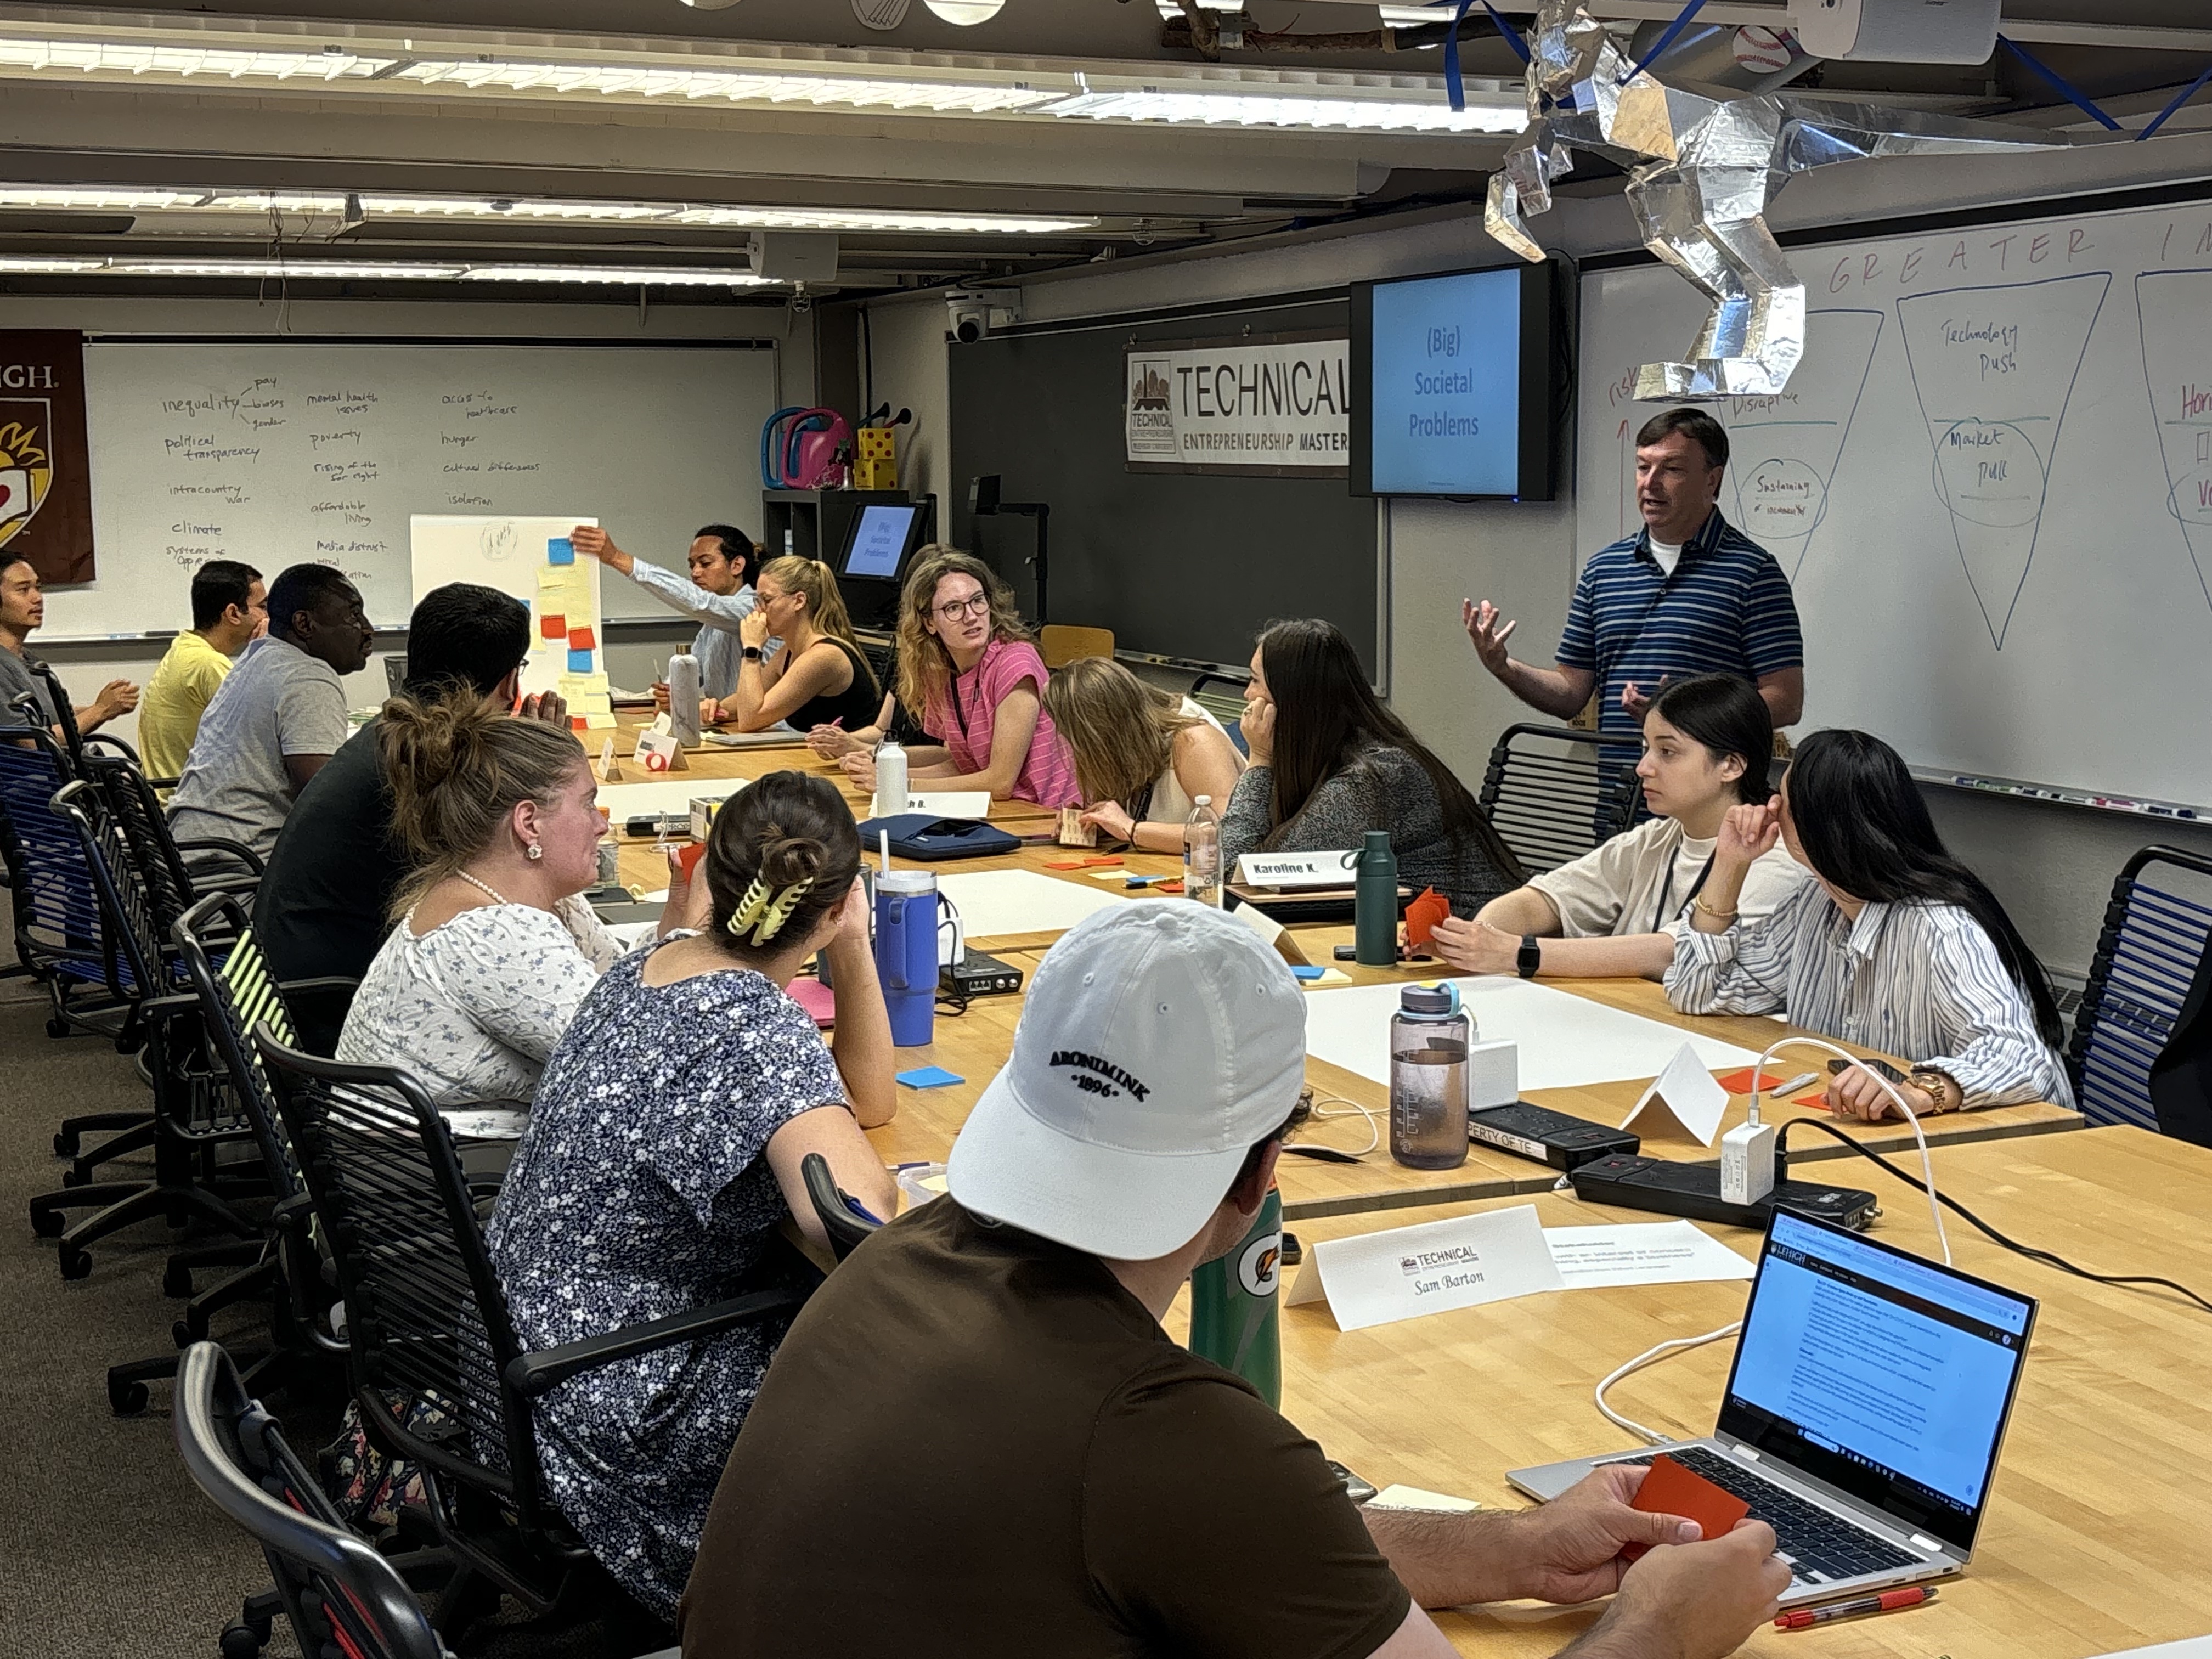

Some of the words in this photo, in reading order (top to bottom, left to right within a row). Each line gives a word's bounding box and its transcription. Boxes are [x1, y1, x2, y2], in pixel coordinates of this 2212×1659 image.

[1830, 229, 2095, 292] GREATER
[1427, 325, 1460, 358] (Big)
[1940, 319, 2018, 353] Technology
[255, 377, 278, 391] pay
[1415, 367, 1472, 395] Societal
[162, 393, 240, 420] inequality
[346, 389, 379, 403] health
[1409, 411, 1479, 437] Problems
[165, 433, 214, 456] political
[309, 428, 362, 450] poverty
[1183, 433, 1294, 450] ENTREPRENEURSHIP
[1951, 429, 2004, 451] Market
[183, 447, 261, 464] transparency
[311, 500, 366, 512] affordable
[1253, 863, 1304, 874] Karoline
[1502, 1133, 1516, 1147] OF
[1417, 1246, 1477, 1266] TECHNICAL
[1414, 1279, 1441, 1296] Sam
[1441, 1271, 1485, 1290] Barton
